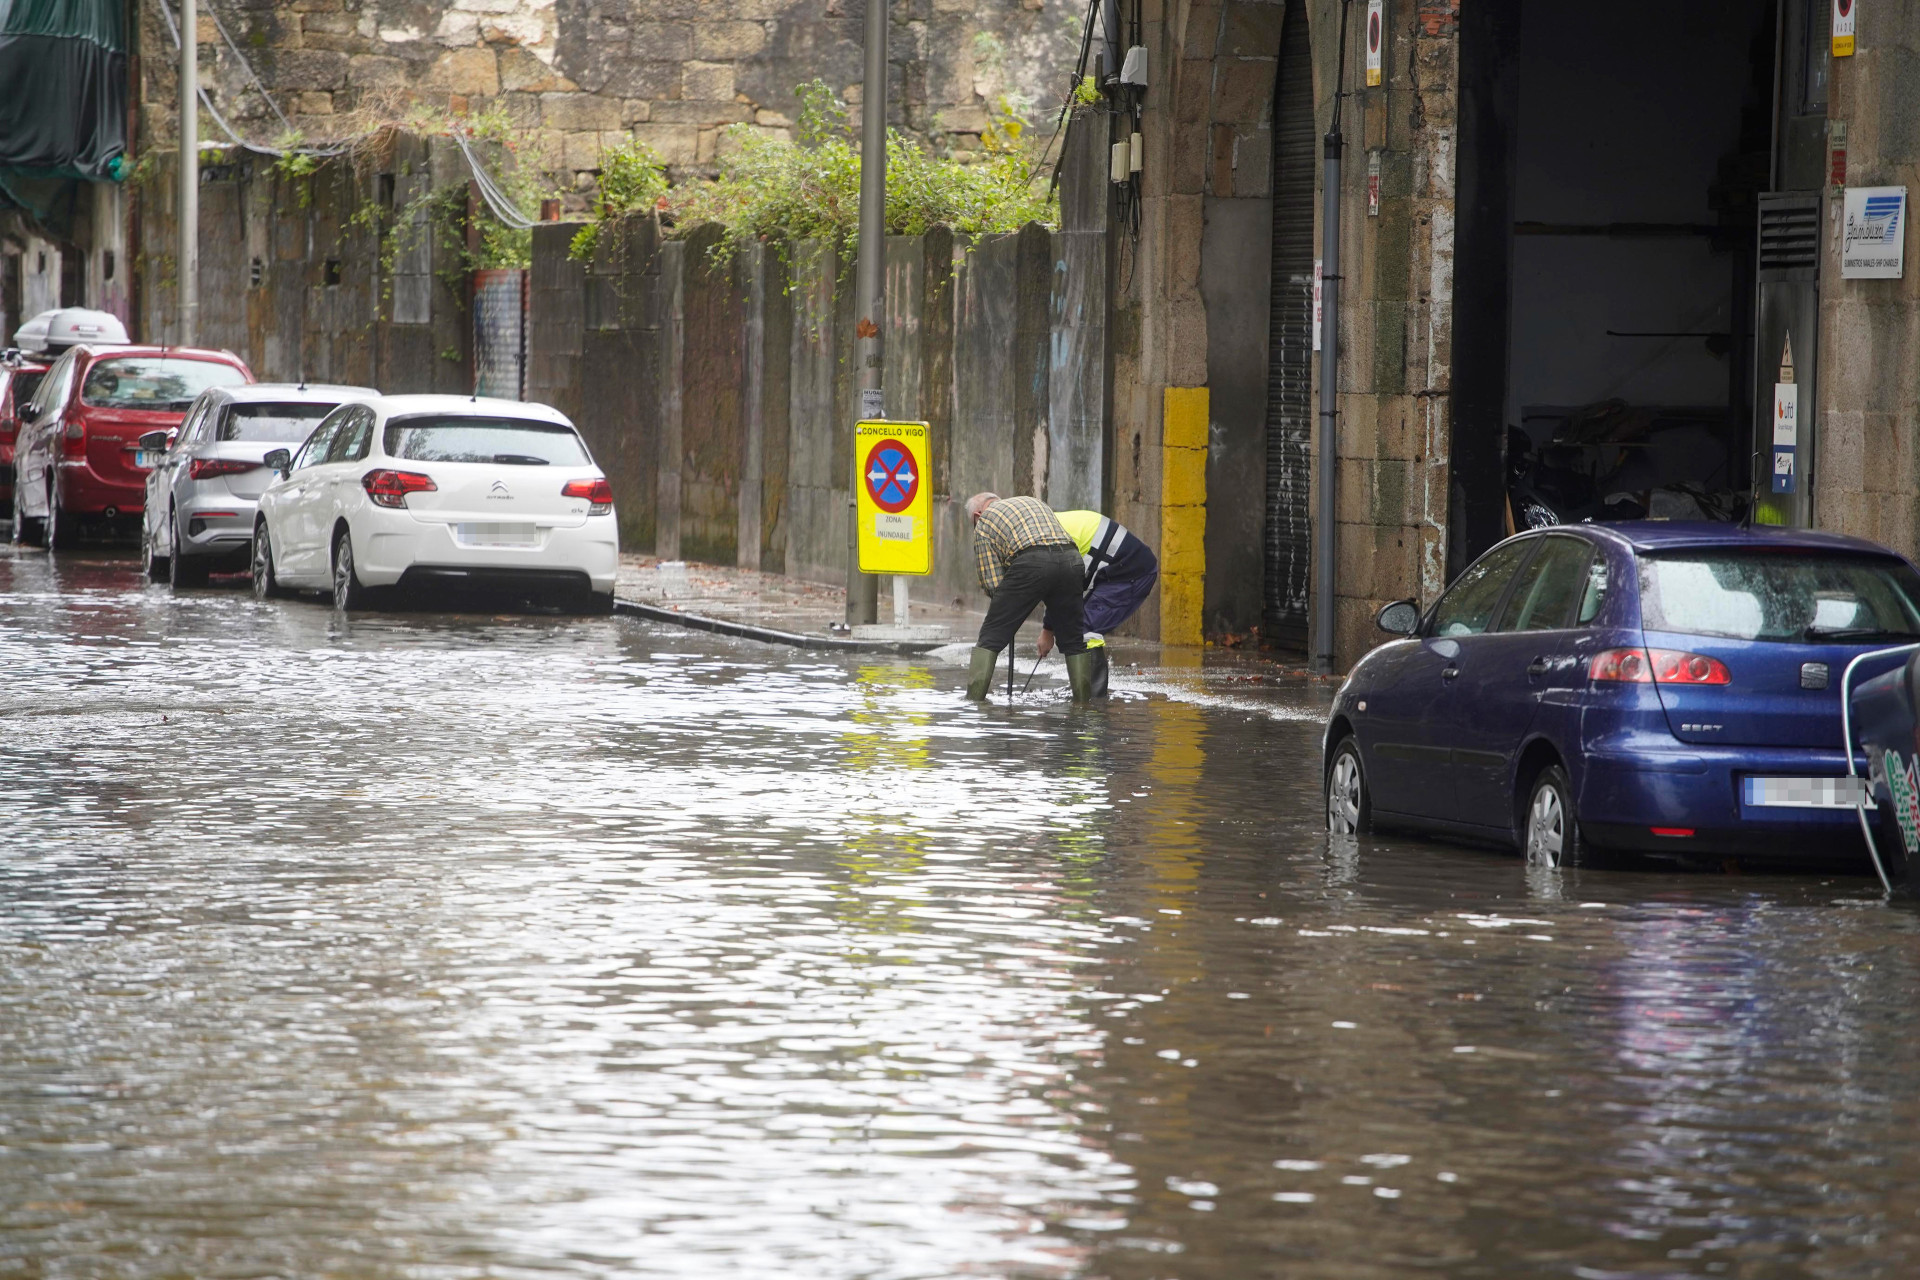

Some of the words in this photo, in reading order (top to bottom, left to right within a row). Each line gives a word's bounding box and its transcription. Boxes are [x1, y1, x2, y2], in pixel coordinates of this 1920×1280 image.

[862, 427, 902, 436] CONCELLO
[904, 428, 924, 437] VIGO
[885, 516, 902, 524] ZONA
[877, 530, 910, 540] INUNDABLE
[1681, 723, 1723, 732] SEAT
